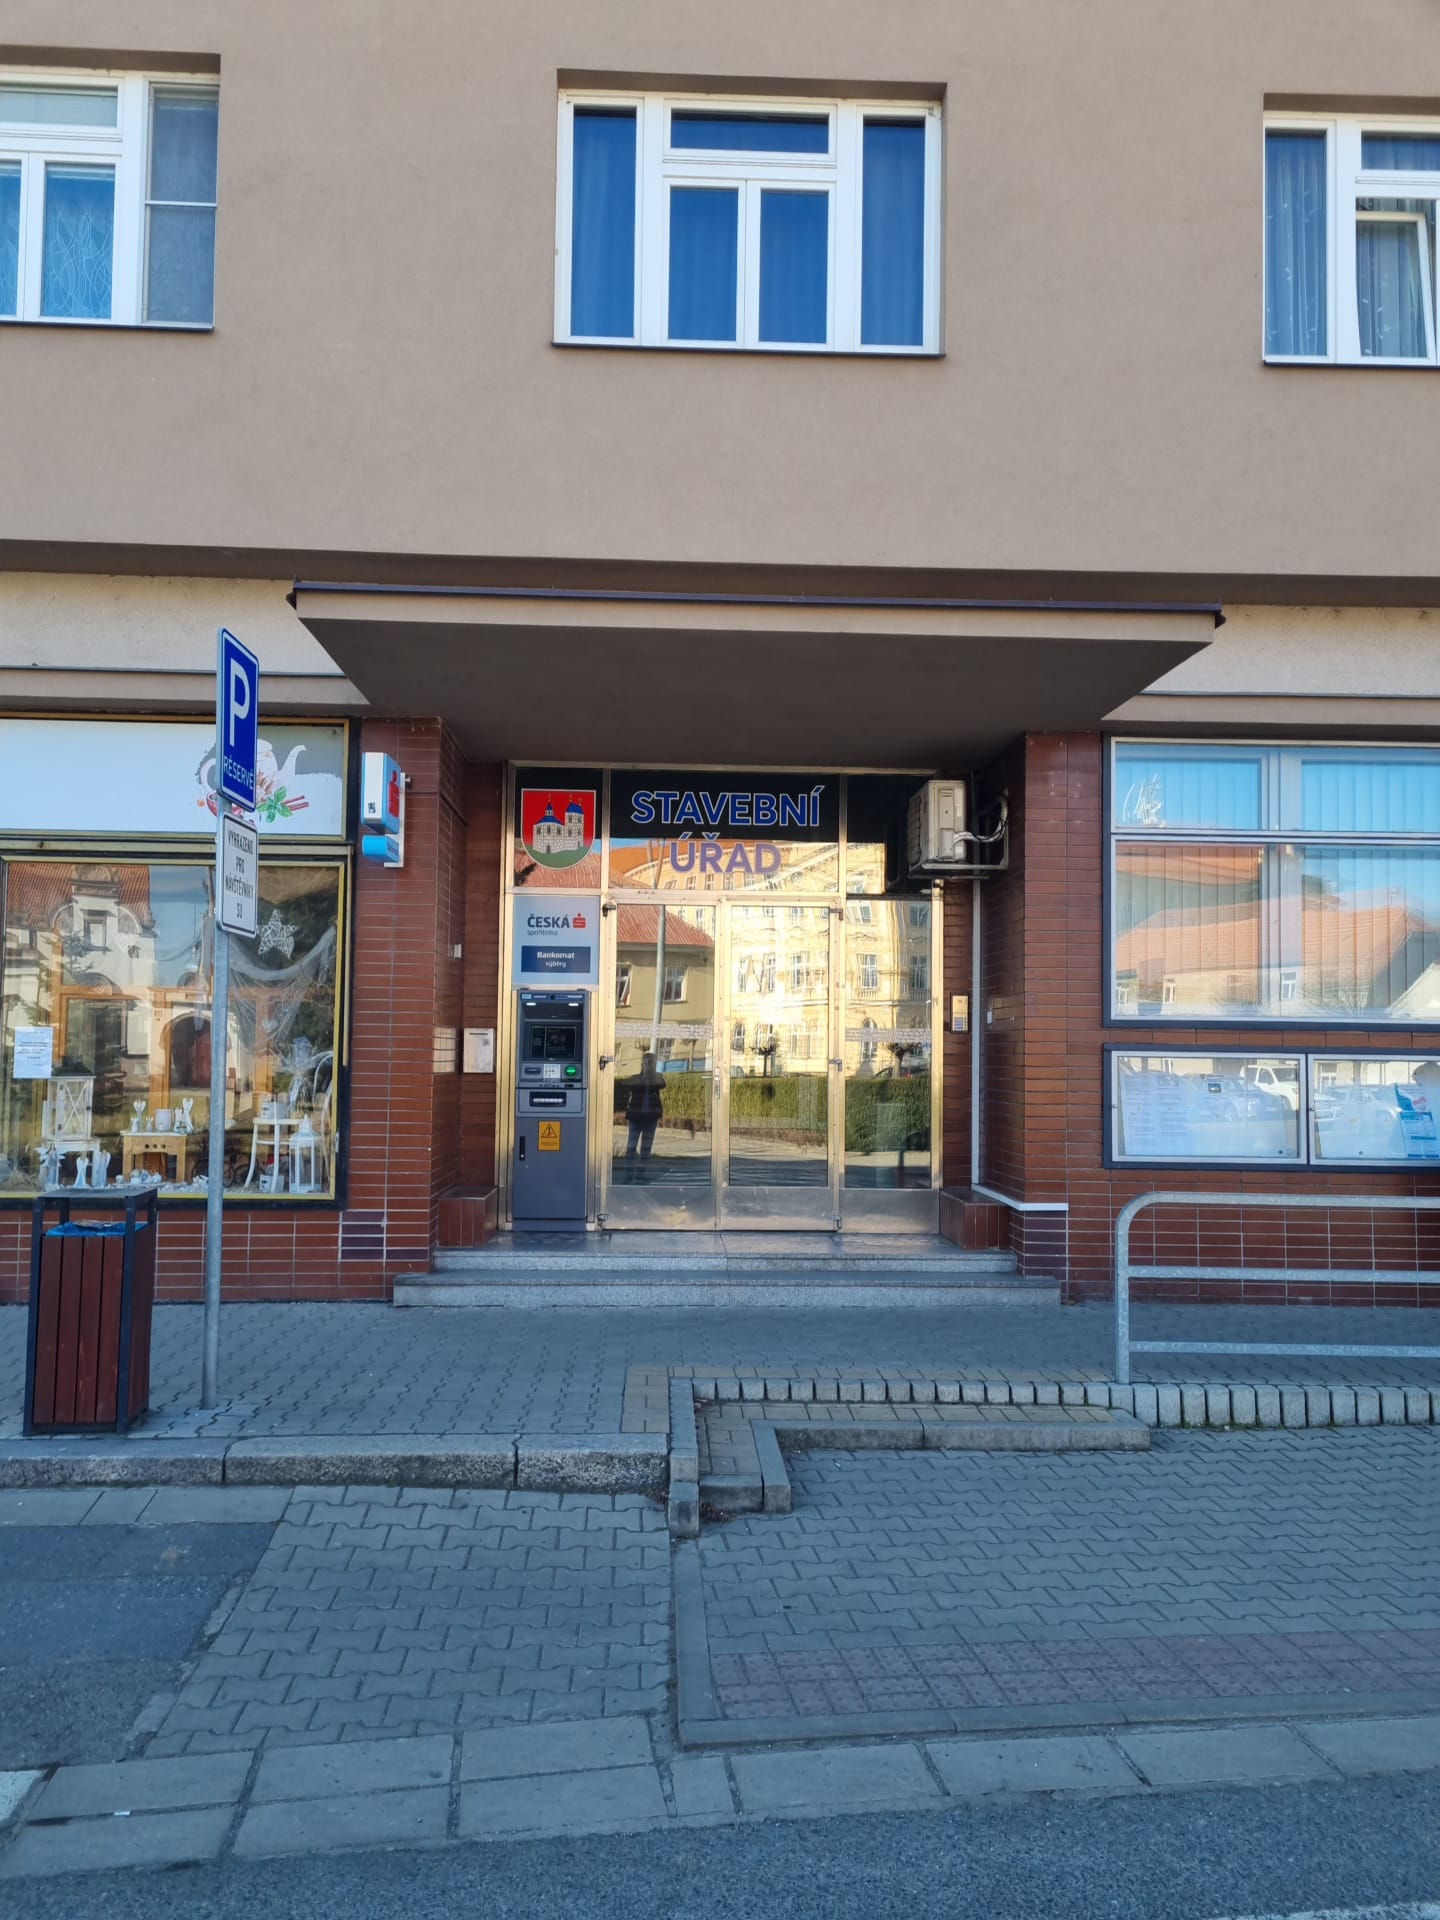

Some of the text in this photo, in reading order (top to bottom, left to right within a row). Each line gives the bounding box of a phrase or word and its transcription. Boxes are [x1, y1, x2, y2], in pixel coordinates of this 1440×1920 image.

[229, 657, 250, 747] P
[223, 755, 254, 790] RÉSERVÉ
[630, 785, 825, 827] STAVEBNÍ
[228, 829, 254, 855] VYHRAZENO
[670, 831, 782, 874] ÚŘAD
[235, 855, 245, 873] PRO
[527, 913, 570, 929] ČESKÁ
[527, 928, 558, 936] spořitelna
[536, 951, 575, 959] Bankomat
[545, 960, 567, 968] výběry
